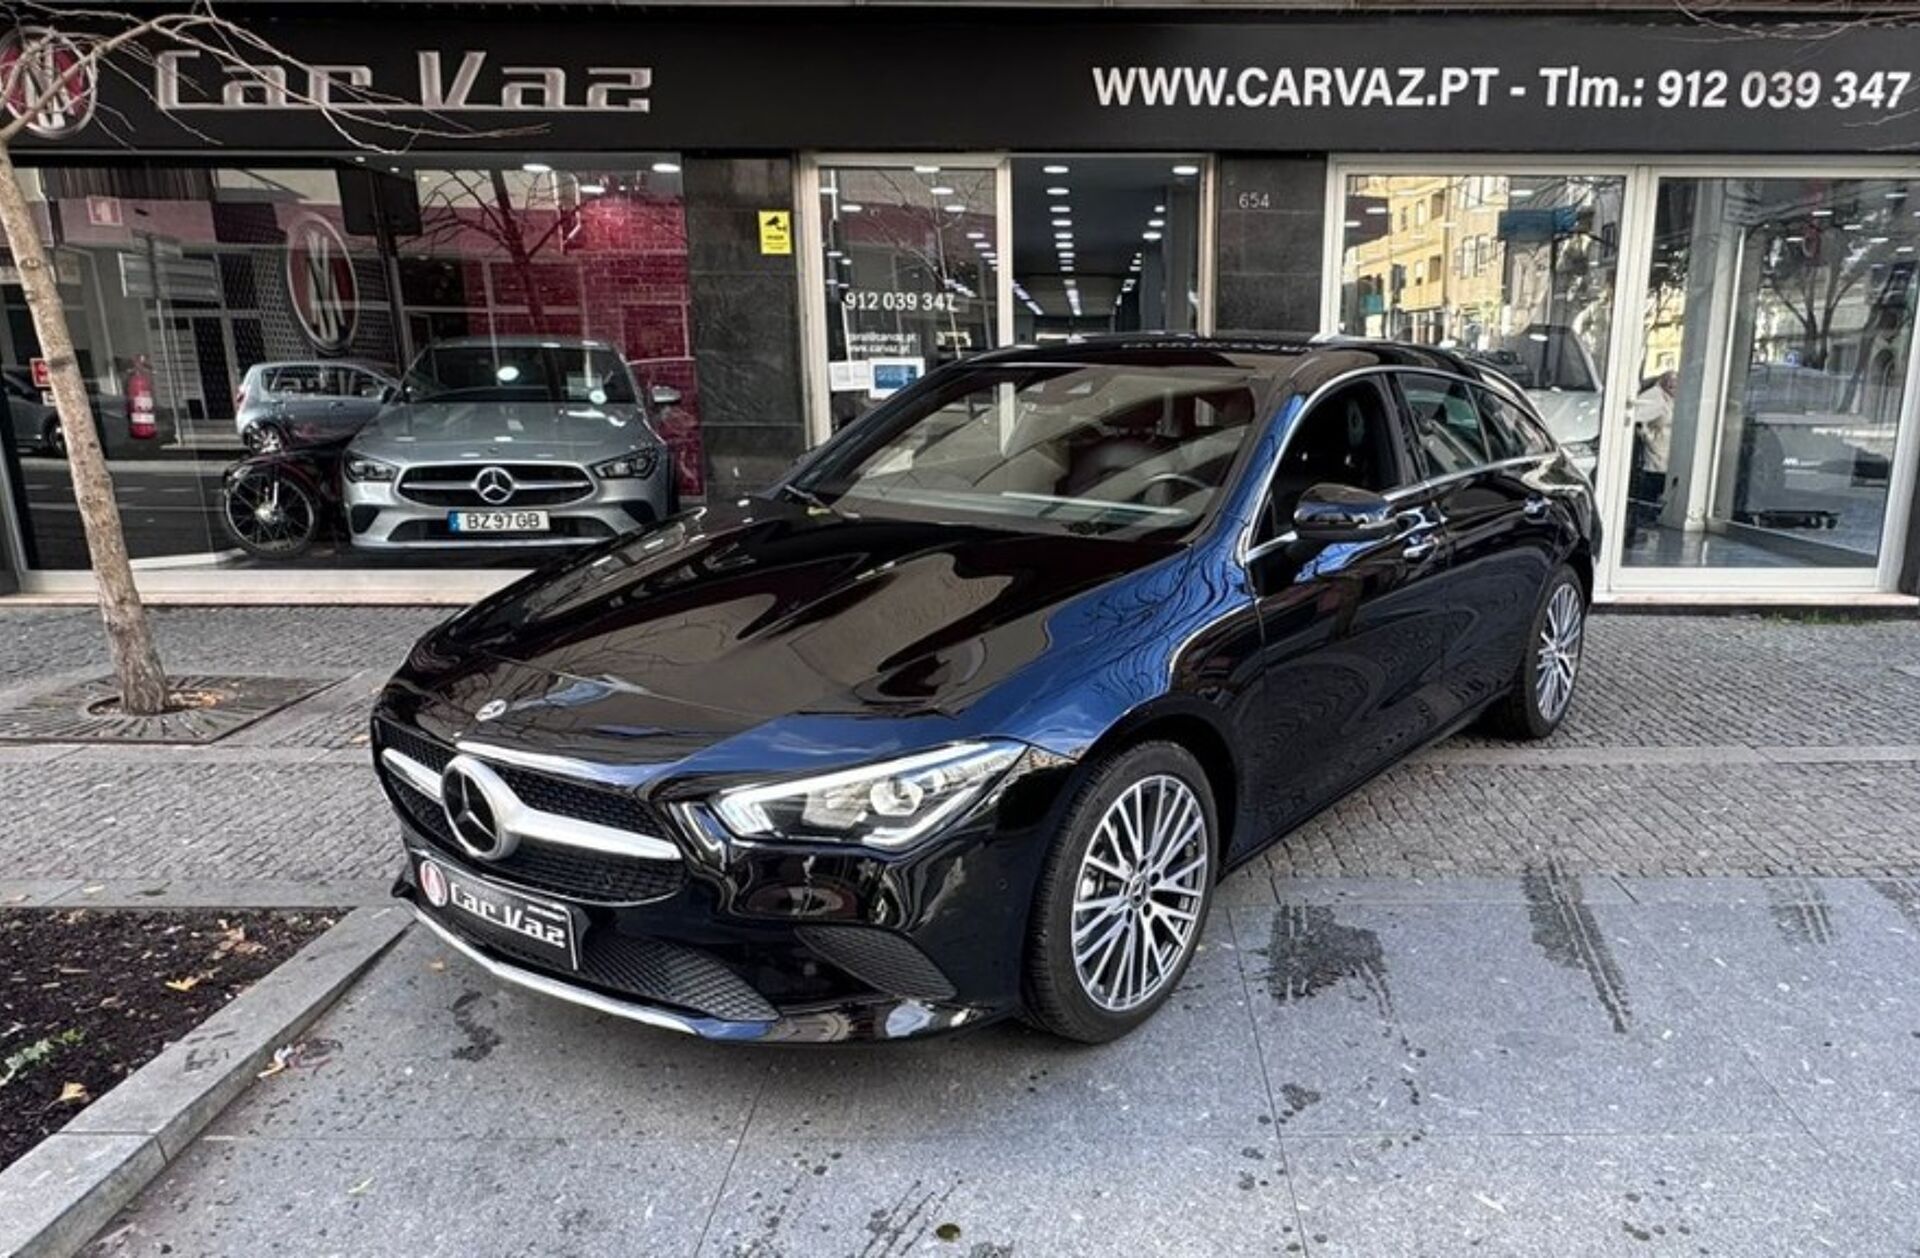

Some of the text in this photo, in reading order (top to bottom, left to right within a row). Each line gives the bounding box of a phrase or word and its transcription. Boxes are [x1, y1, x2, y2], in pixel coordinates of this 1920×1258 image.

[156, 50, 651, 112] Car Vaz
[1092, 66, 1500, 108] WWW.CARVAZ.PT
[1539, 66, 1645, 107] Tlm.:
[1657, 70, 1729, 108] 912
[1740, 71, 1822, 108] 039
[1831, 71, 1912, 108] 347
[1239, 192, 1269, 208] 654
[845, 291, 878, 310] 912
[883, 291, 917, 310] 039
